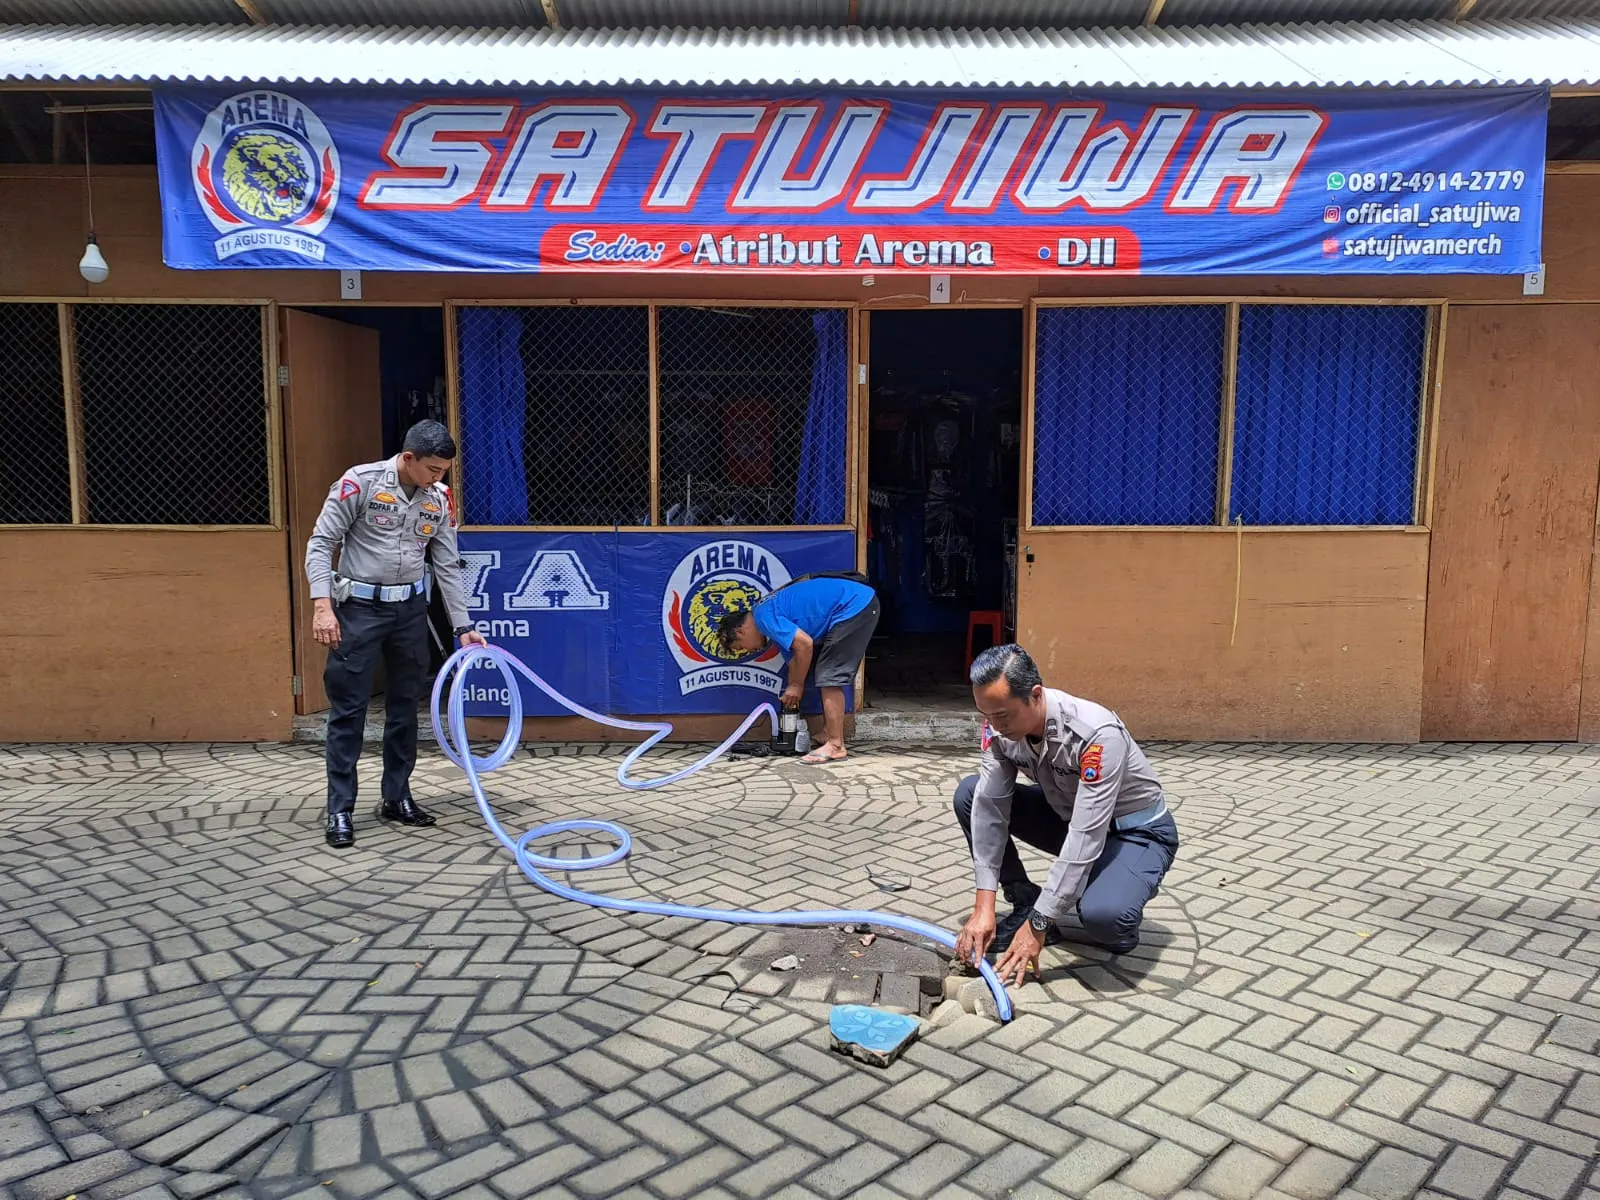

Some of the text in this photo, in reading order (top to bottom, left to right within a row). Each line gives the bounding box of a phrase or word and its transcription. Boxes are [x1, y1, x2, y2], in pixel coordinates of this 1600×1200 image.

[221, 94, 309, 139] AREMA
[361, 101, 1327, 210] SATUJIWA
[1348, 170, 1525, 192] 0812-4914-2779
[1345, 202, 1521, 228] official_satujiwa
[220, 233, 320, 254] 11 AGUSTUS 1987
[565, 230, 665, 261] Sedia:
[692, 232, 841, 266] Atribut
[854, 233, 995, 267] Arema
[1343, 234, 1502, 262] satujiwamerch
[347, 278, 355, 290] 3
[936, 282, 944, 294] 4
[1530, 273, 1539, 285] 5
[689, 544, 772, 585] AREMA
[685, 670, 778, 689] 11 AGUSTUS 1987
